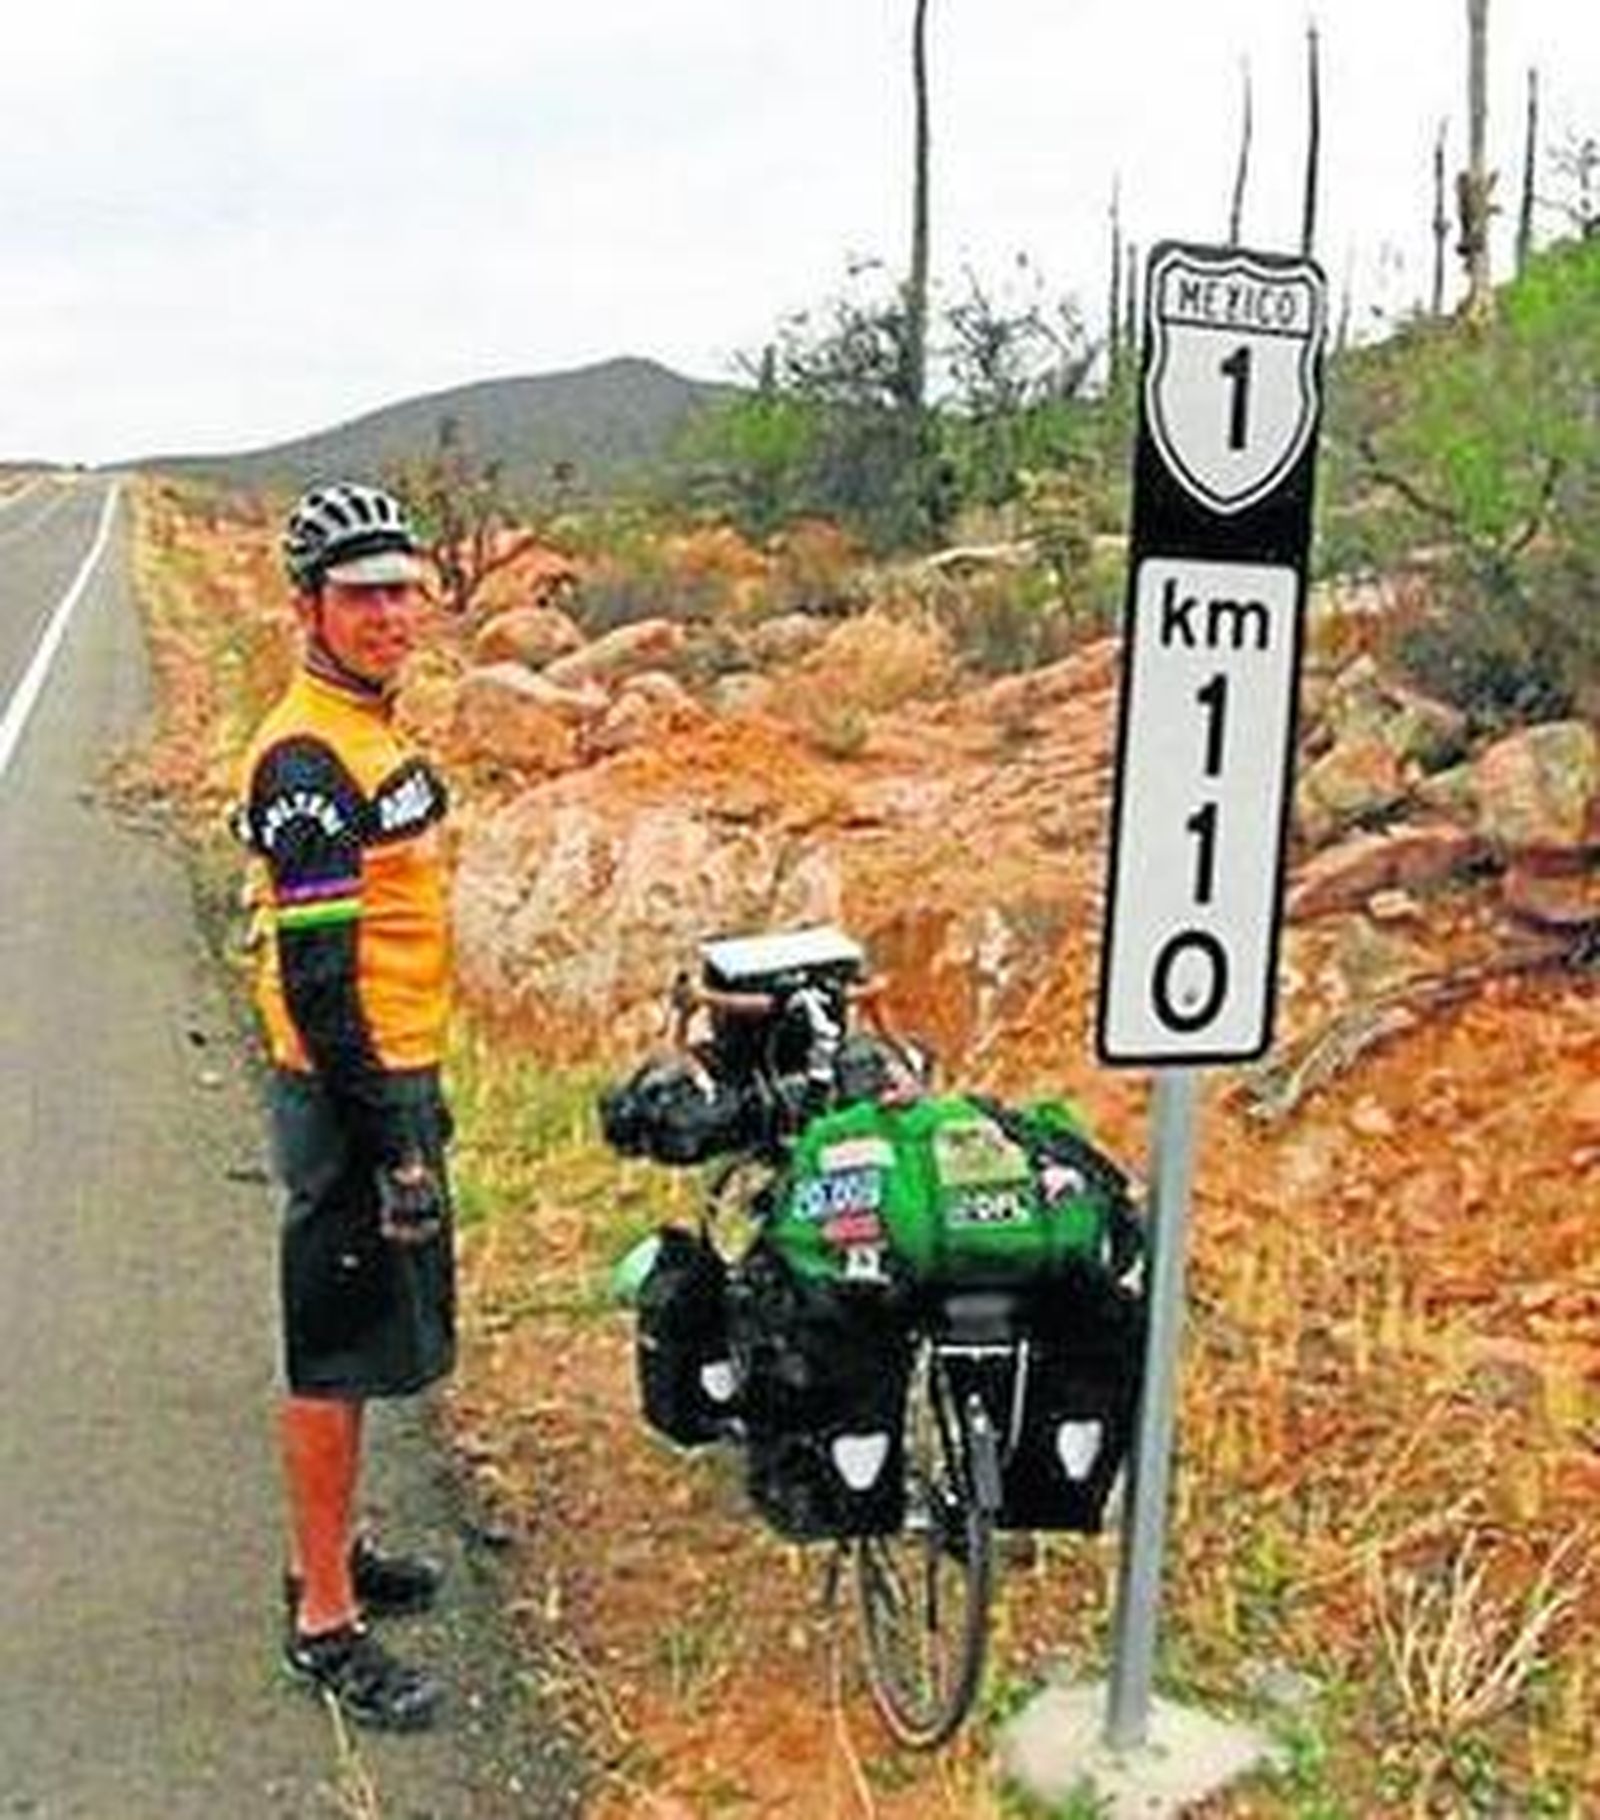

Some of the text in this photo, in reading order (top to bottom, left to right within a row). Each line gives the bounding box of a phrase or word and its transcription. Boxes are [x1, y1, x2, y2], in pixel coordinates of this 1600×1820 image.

[1177, 279, 1298, 327] MEXICO
[1219, 344, 1252, 452] 1
[1160, 577, 1271, 652] km
